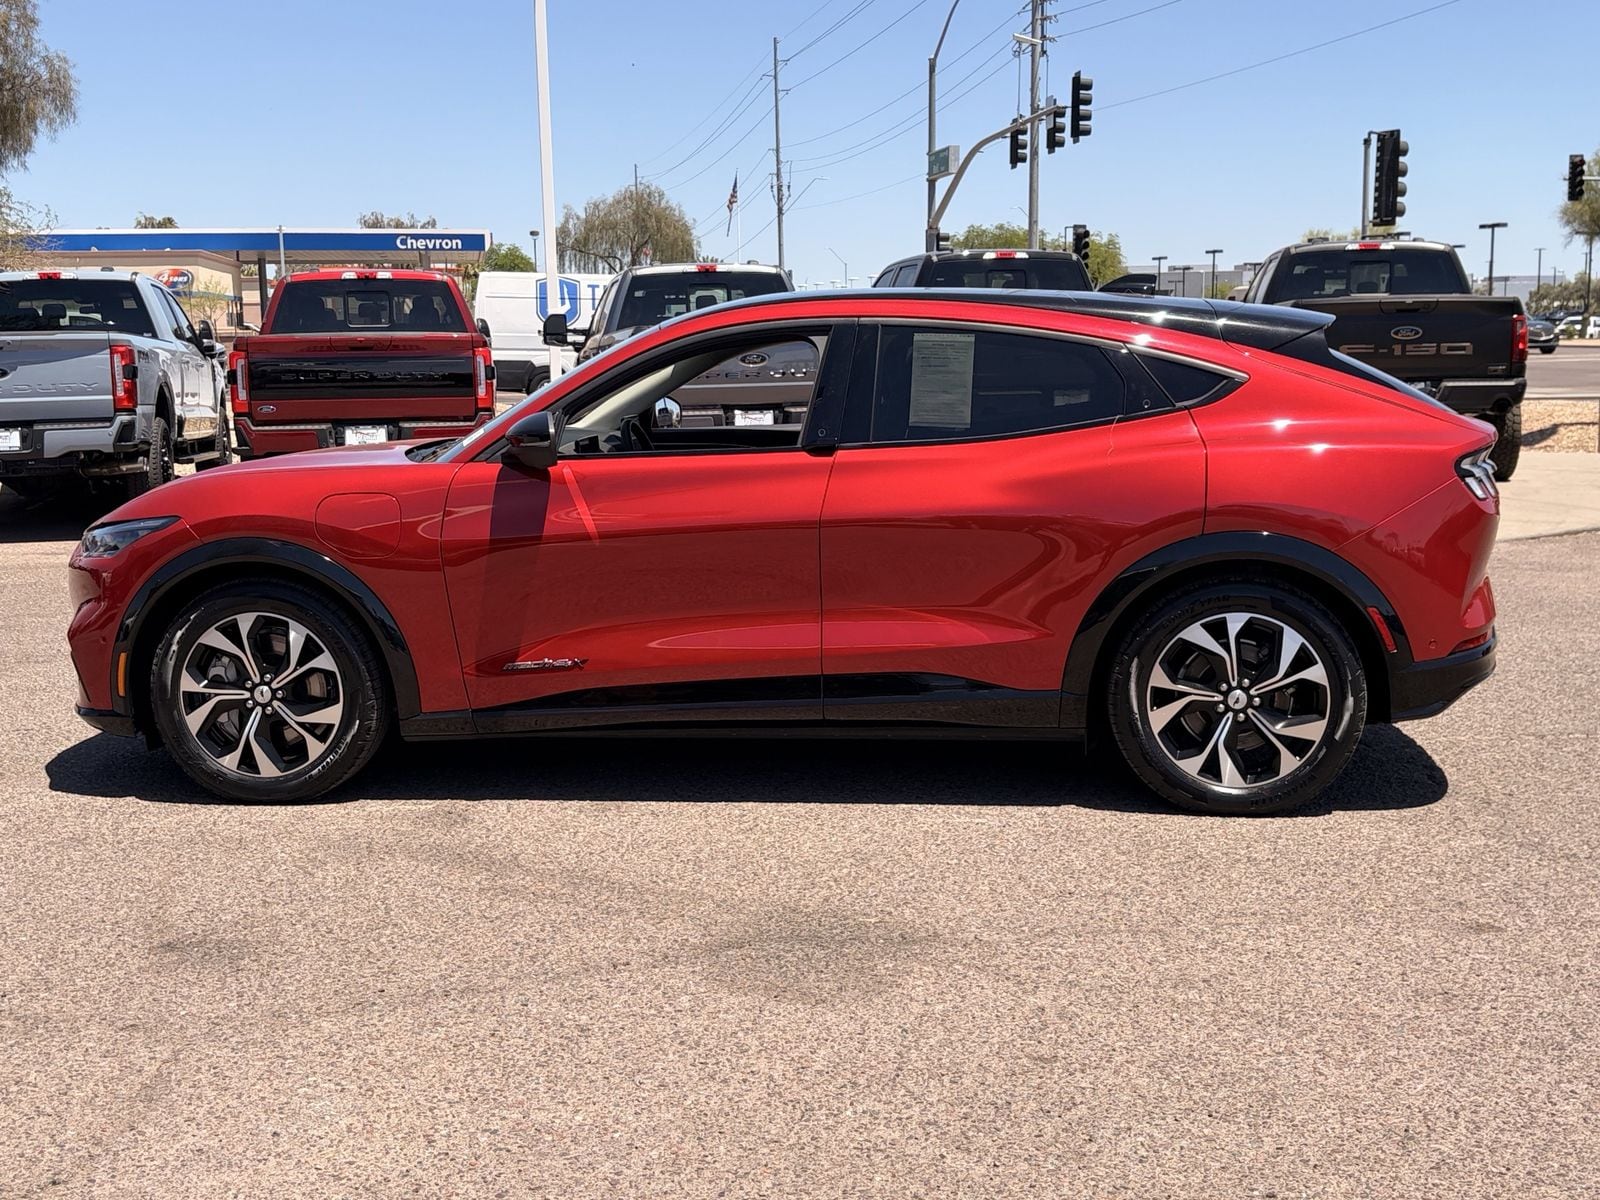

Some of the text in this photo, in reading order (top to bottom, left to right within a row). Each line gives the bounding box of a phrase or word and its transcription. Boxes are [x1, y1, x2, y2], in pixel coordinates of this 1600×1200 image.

[396, 236, 462, 250] Chevron
[158, 271, 170, 285] 4
[1339, 342, 1473, 356] F-150
[280, 370, 371, 381] SUPER
[12, 382, 100, 394] DUTY
